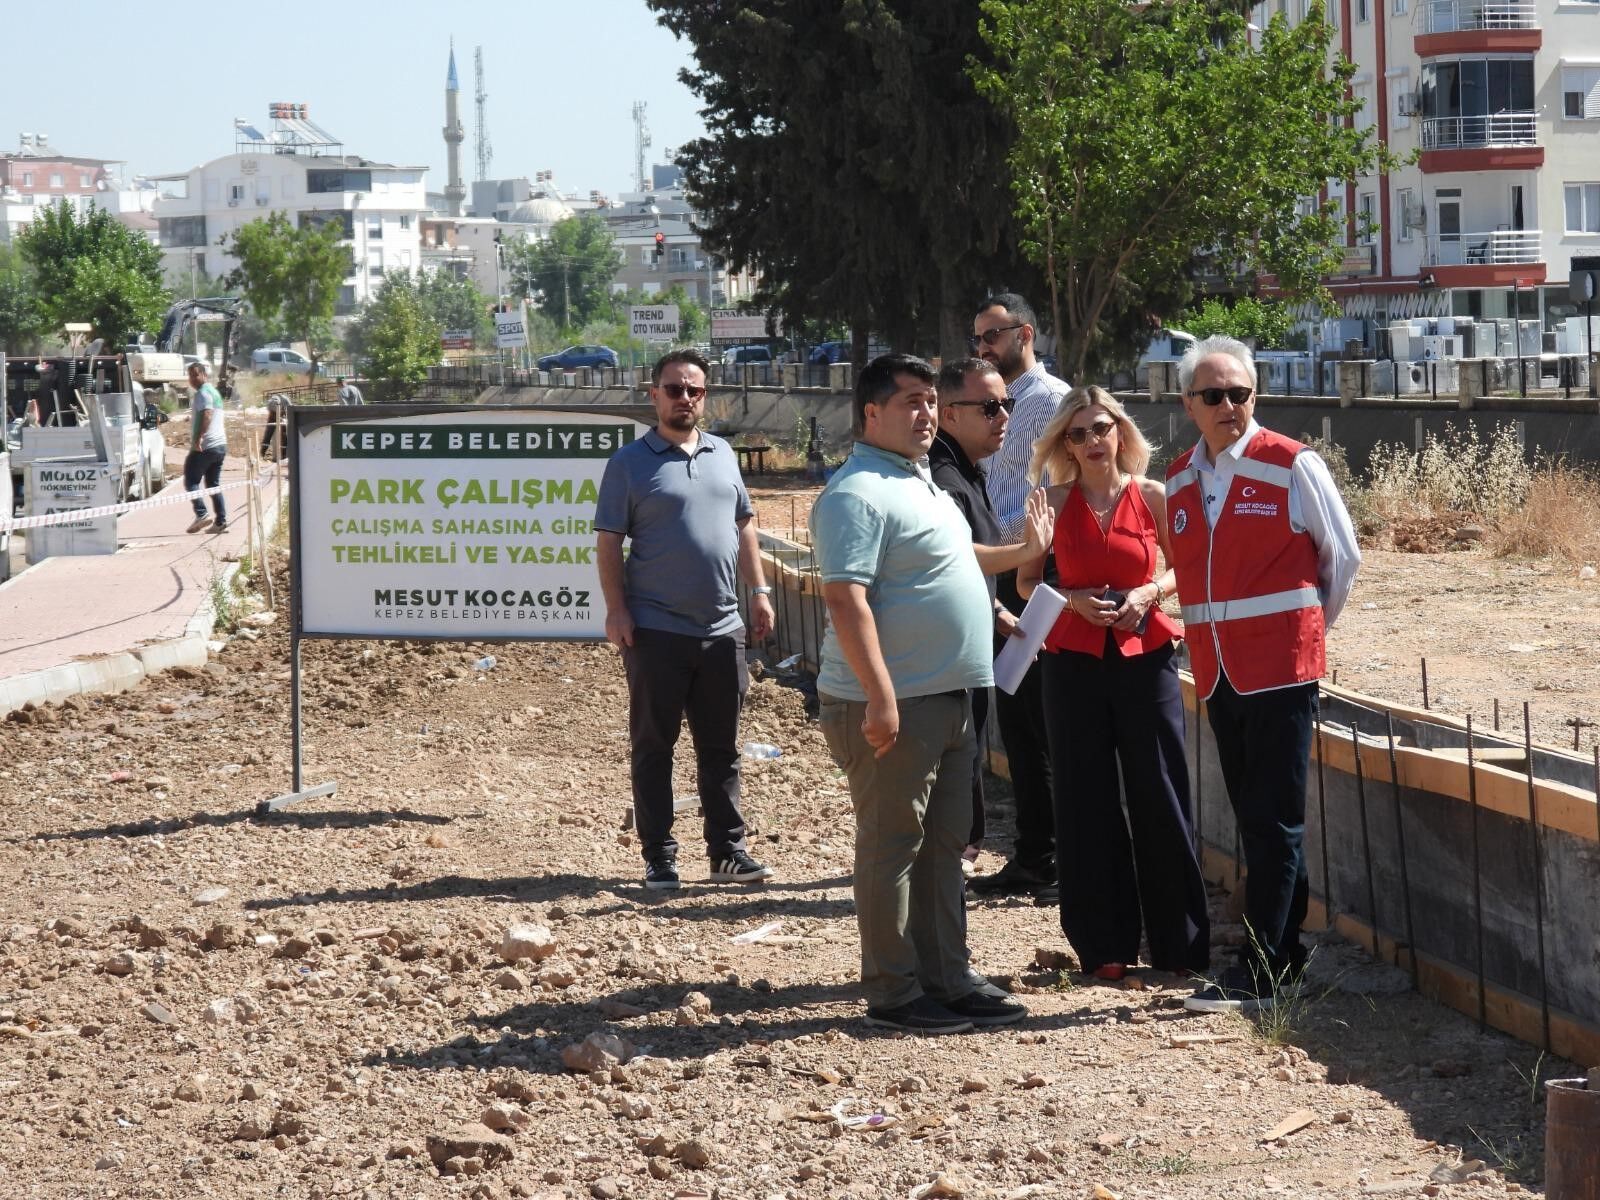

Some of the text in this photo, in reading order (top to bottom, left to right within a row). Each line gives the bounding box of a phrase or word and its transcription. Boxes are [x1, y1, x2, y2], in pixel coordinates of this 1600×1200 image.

[633, 310, 664, 320] TREND
[499, 323, 523, 335] SPOT
[633, 323, 648, 334] OTO
[341, 427, 624, 450] KEPEZ BELEDİYESİ
[40, 470, 97, 481] MOLOZ
[330, 479, 425, 504] PARK
[331, 519, 425, 537] ÇALIŞMA
[432, 519, 543, 535] SAHASINA
[332, 541, 457, 564] TEHLİKELİ
[465, 546, 498, 564] VE
[374, 586, 590, 607] MESUT KOCAGÖZ
[374, 608, 590, 622] KEPEZ BELEDİYE BAŞKANI
